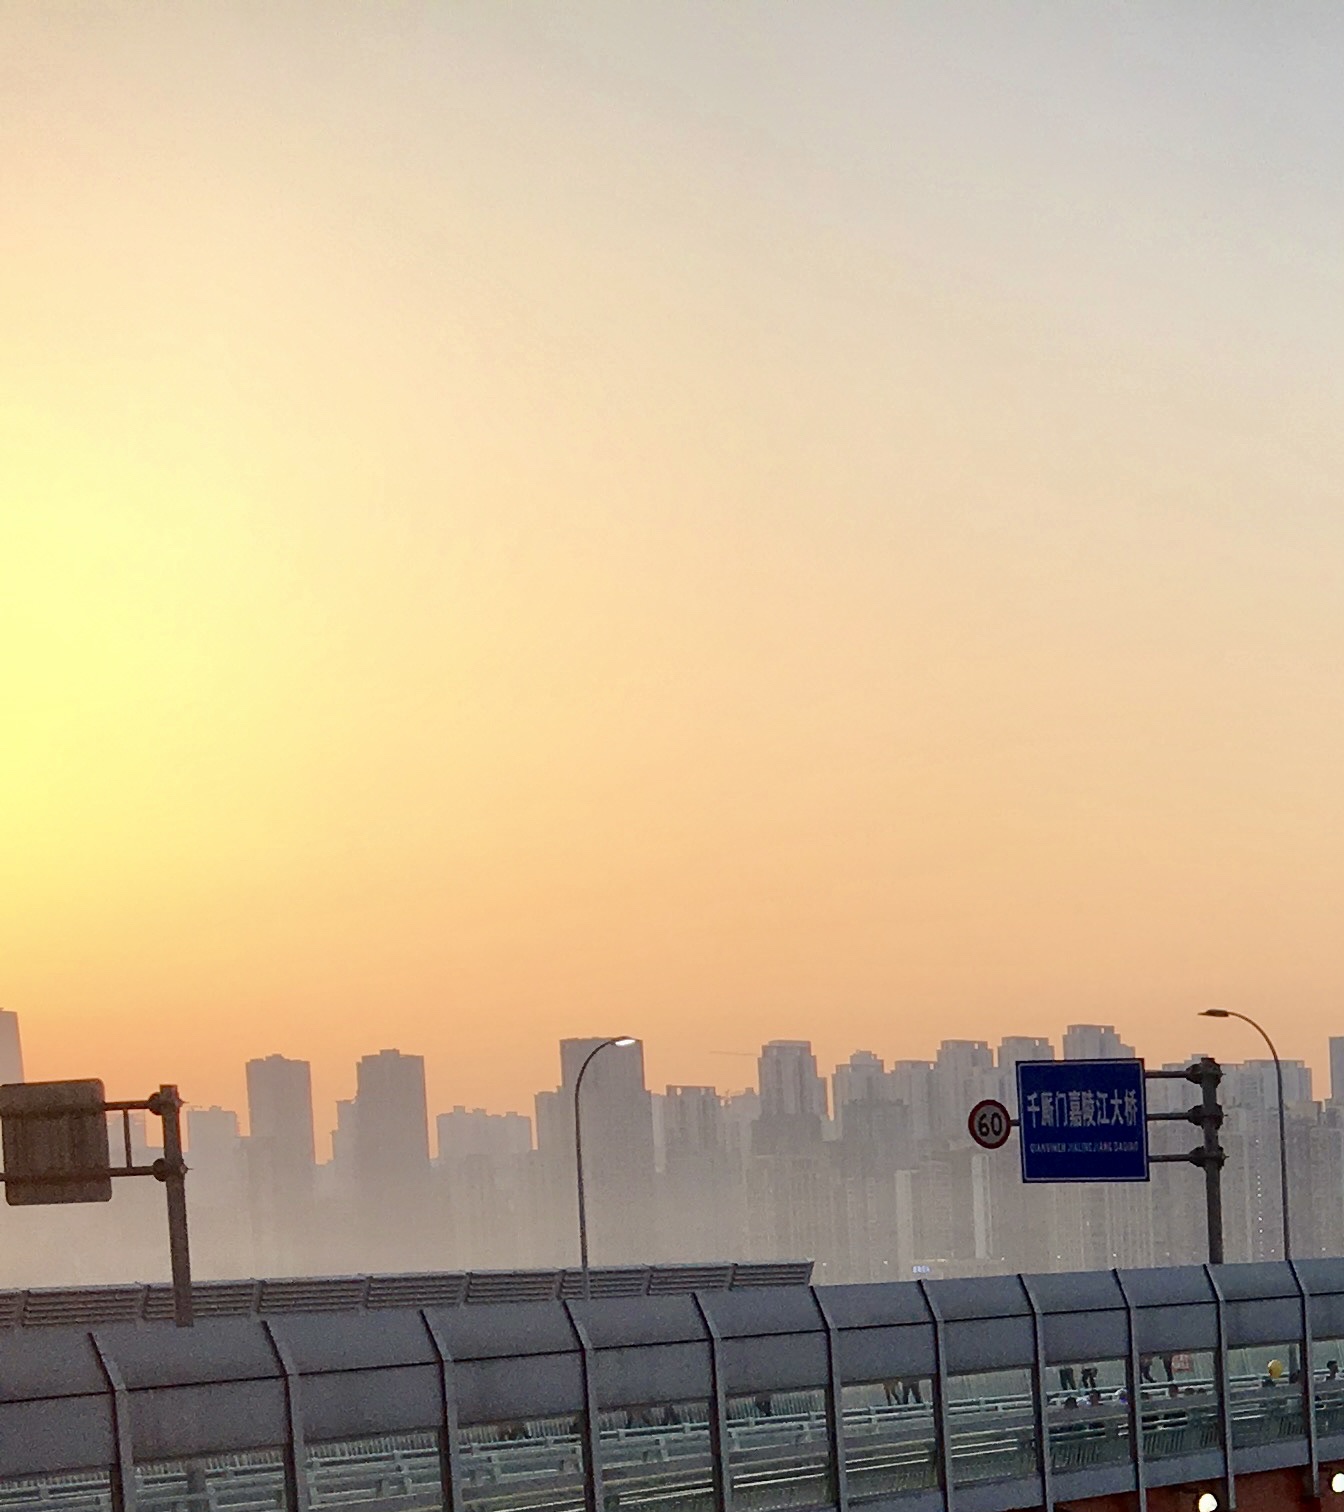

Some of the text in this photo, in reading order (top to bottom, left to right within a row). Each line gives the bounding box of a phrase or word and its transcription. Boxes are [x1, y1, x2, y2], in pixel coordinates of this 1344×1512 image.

[1026, 1088, 1138, 1128] 千厮门嘉陵江大桥
[978, 1112, 1002, 1137] 60
